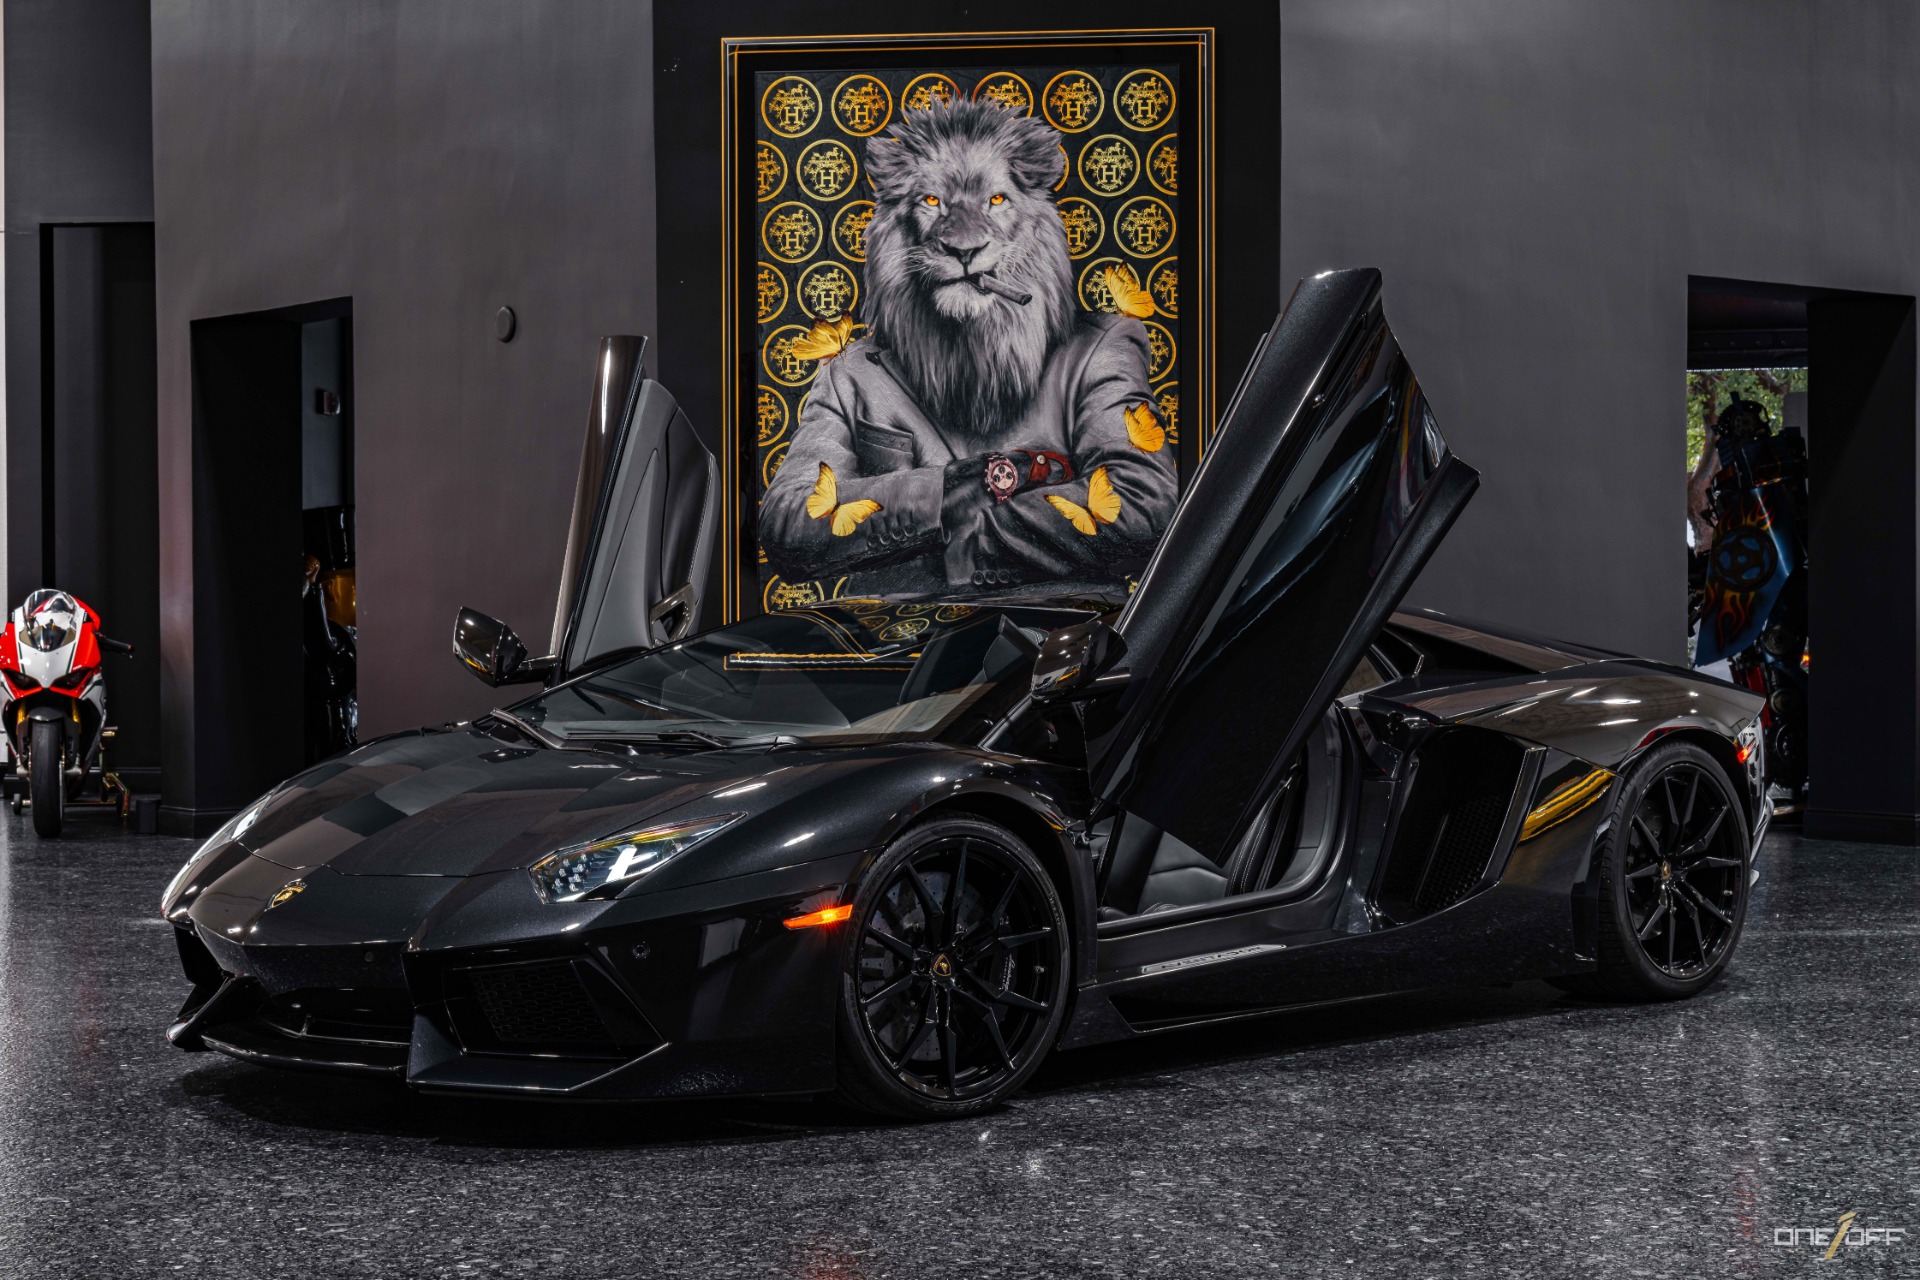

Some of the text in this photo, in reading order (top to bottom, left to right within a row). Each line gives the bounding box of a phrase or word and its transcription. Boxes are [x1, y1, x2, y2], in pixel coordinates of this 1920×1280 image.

[784, 106, 800, 124] H
[854, 105, 870, 123] H
[1065, 101, 1083, 119] H
[1137, 100, 1153, 118] H
[820, 169, 836, 188] H
[1101, 165, 1118, 183] H
[785, 232, 801, 249] H
[1066, 228, 1082, 245] H
[1137, 227, 1153, 245] H
[820, 290, 836, 309] H
[785, 355, 801, 373] H
